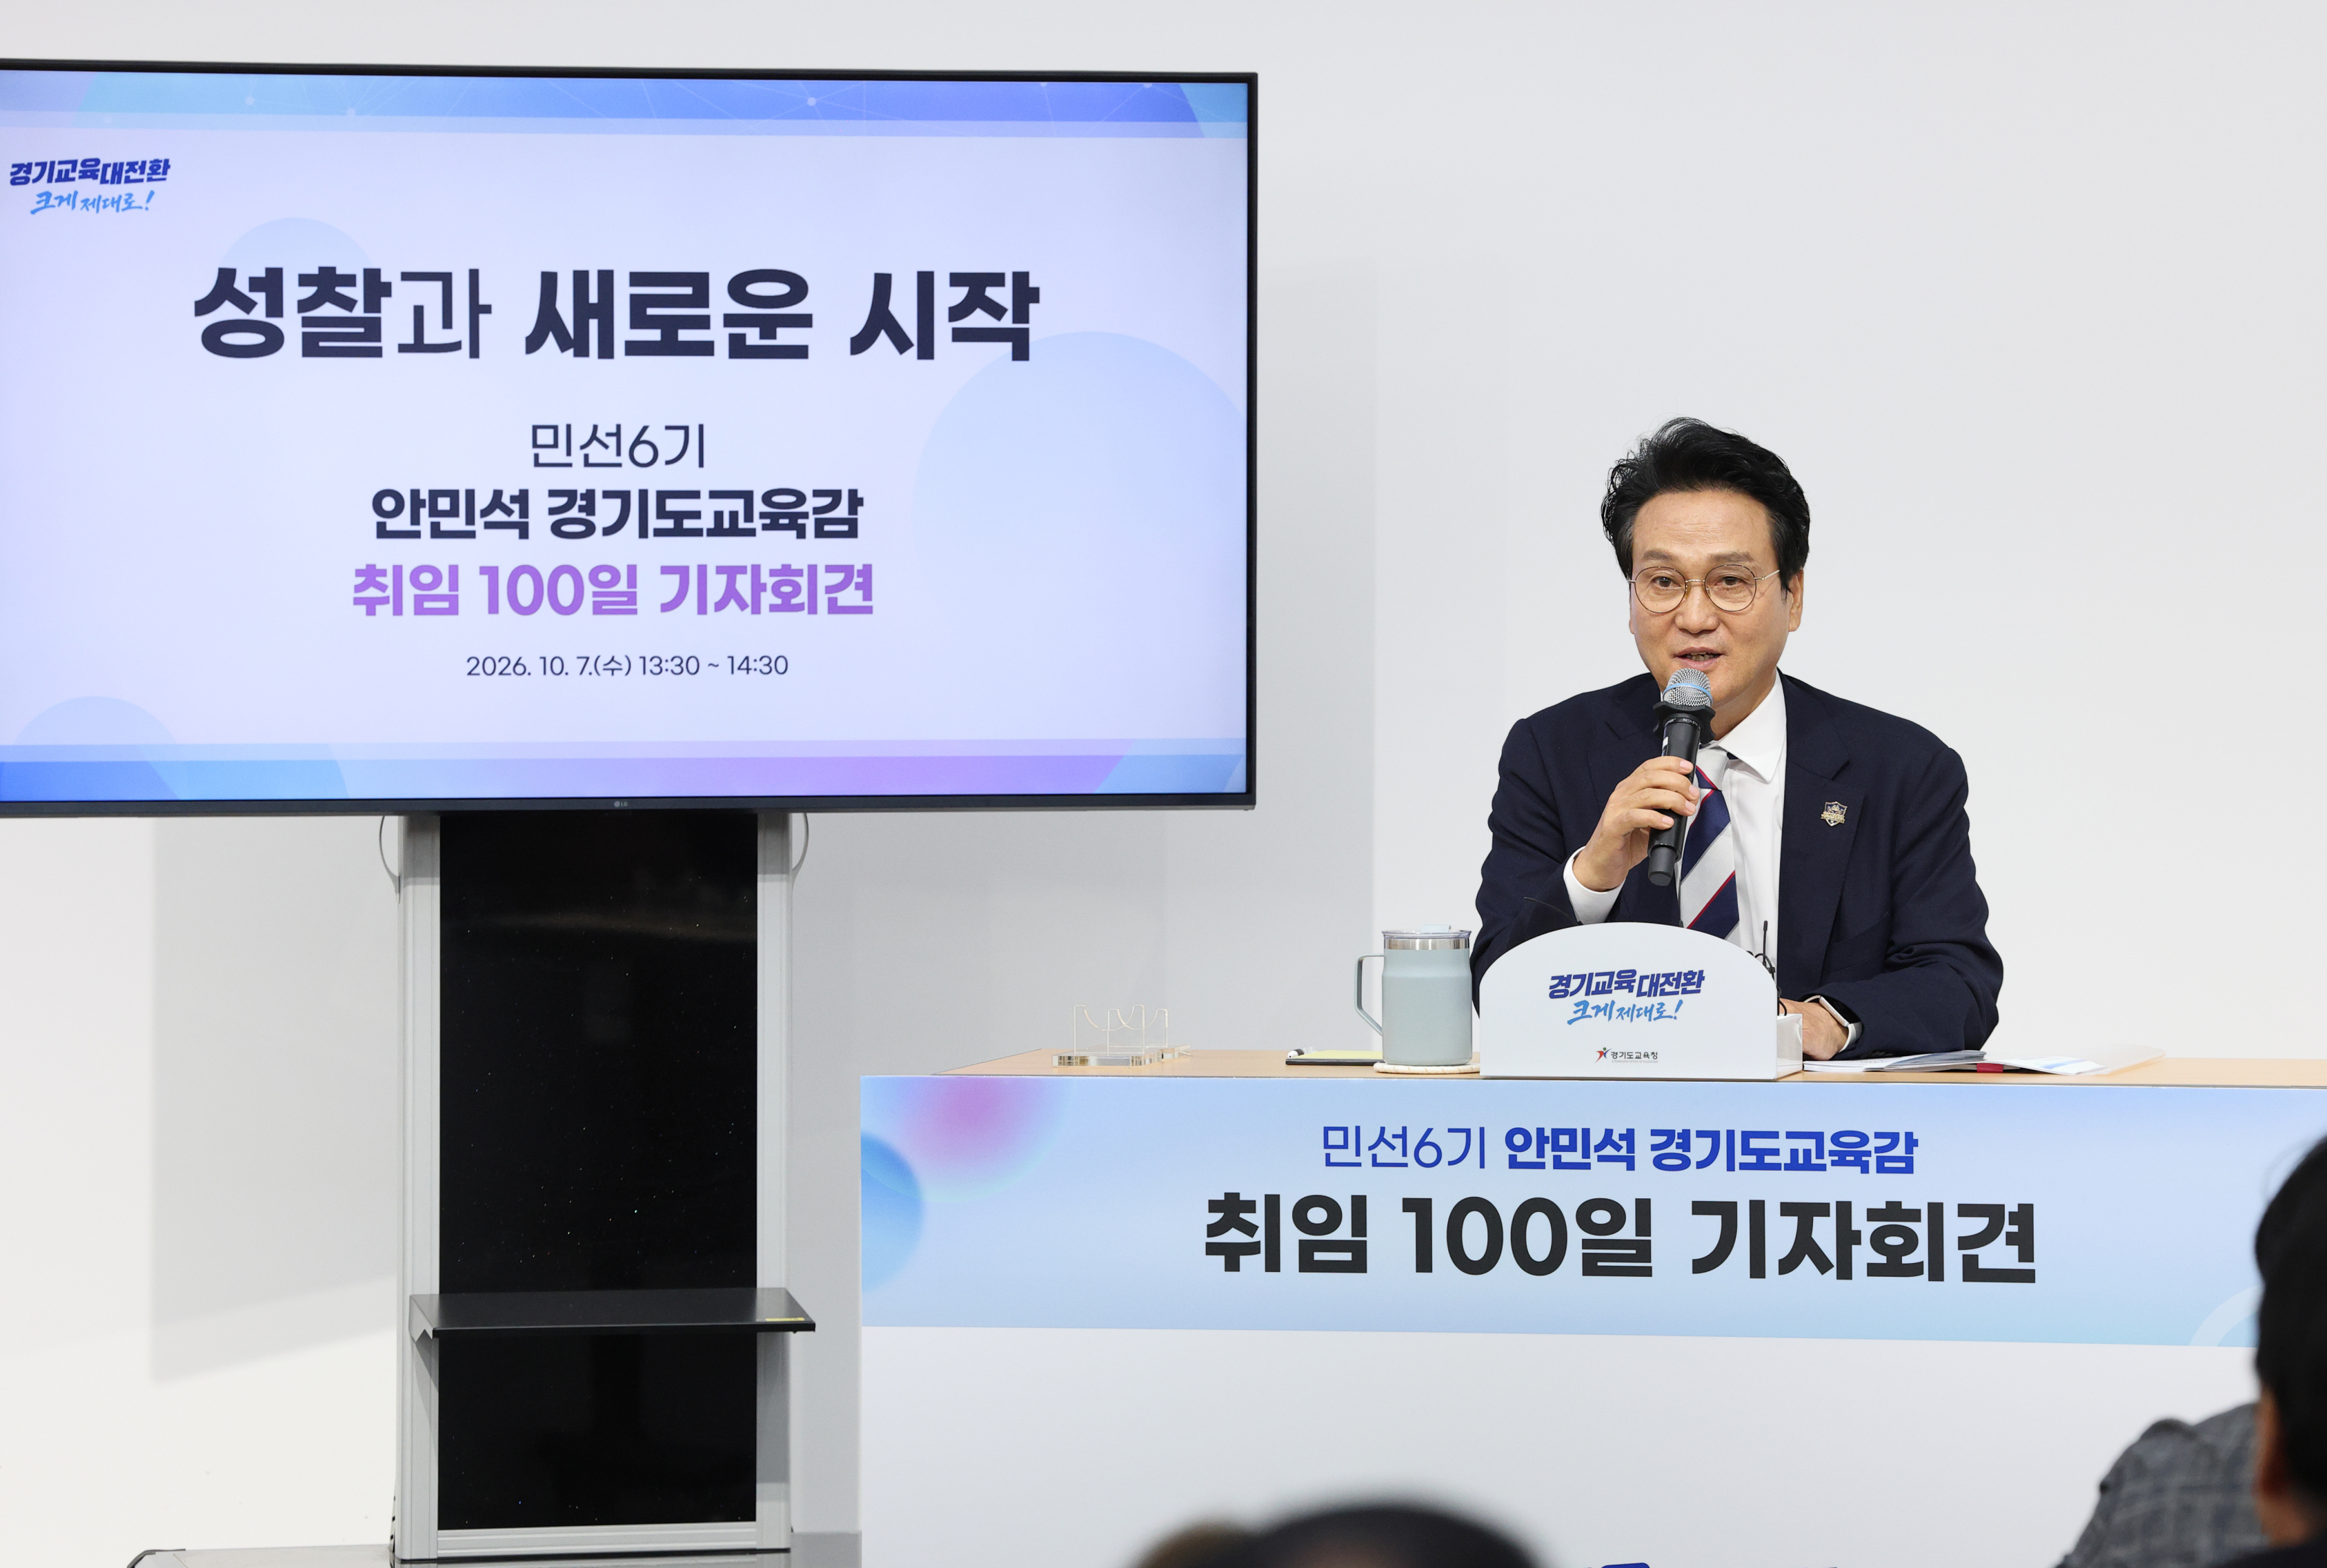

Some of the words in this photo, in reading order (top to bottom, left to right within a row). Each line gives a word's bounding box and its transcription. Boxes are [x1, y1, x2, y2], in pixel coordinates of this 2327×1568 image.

[30, 190, 79, 215] 크게
[80, 190, 155, 215] 제대로!
[195, 266, 492, 359] 성찰과
[525, 269, 813, 359] 새로운
[850, 270, 1040, 361] 시작
[532, 424, 704, 468] 민선6기
[372, 488, 529, 539] 안민석
[548, 488, 864, 539] 경기도교육감
[353, 564, 459, 616] 취임
[479, 564, 637, 615] 100일
[660, 564, 873, 615] 기자회견
[466, 655, 532, 676] 2026.
[539, 656, 569, 676] 10.
[577, 655, 632, 677] 7.(수)
[639, 655, 700, 676] 13:30
[727, 655, 789, 675] 14:30
[1567, 1000, 1616, 1025] 크게
[1616, 999, 1683, 1023] 제대로!
[1611, 1051, 1658, 1060] 경기도교육청
[1323, 1126, 1485, 1169] 민선6기
[1505, 1127, 1636, 1171] 안민석
[1650, 1129, 1919, 1175] 경기도교육감
[1205, 1192, 1368, 1273] 취임
[1402, 1196, 1653, 1278] 100일
[1692, 1200, 2036, 1283] 기자회견
